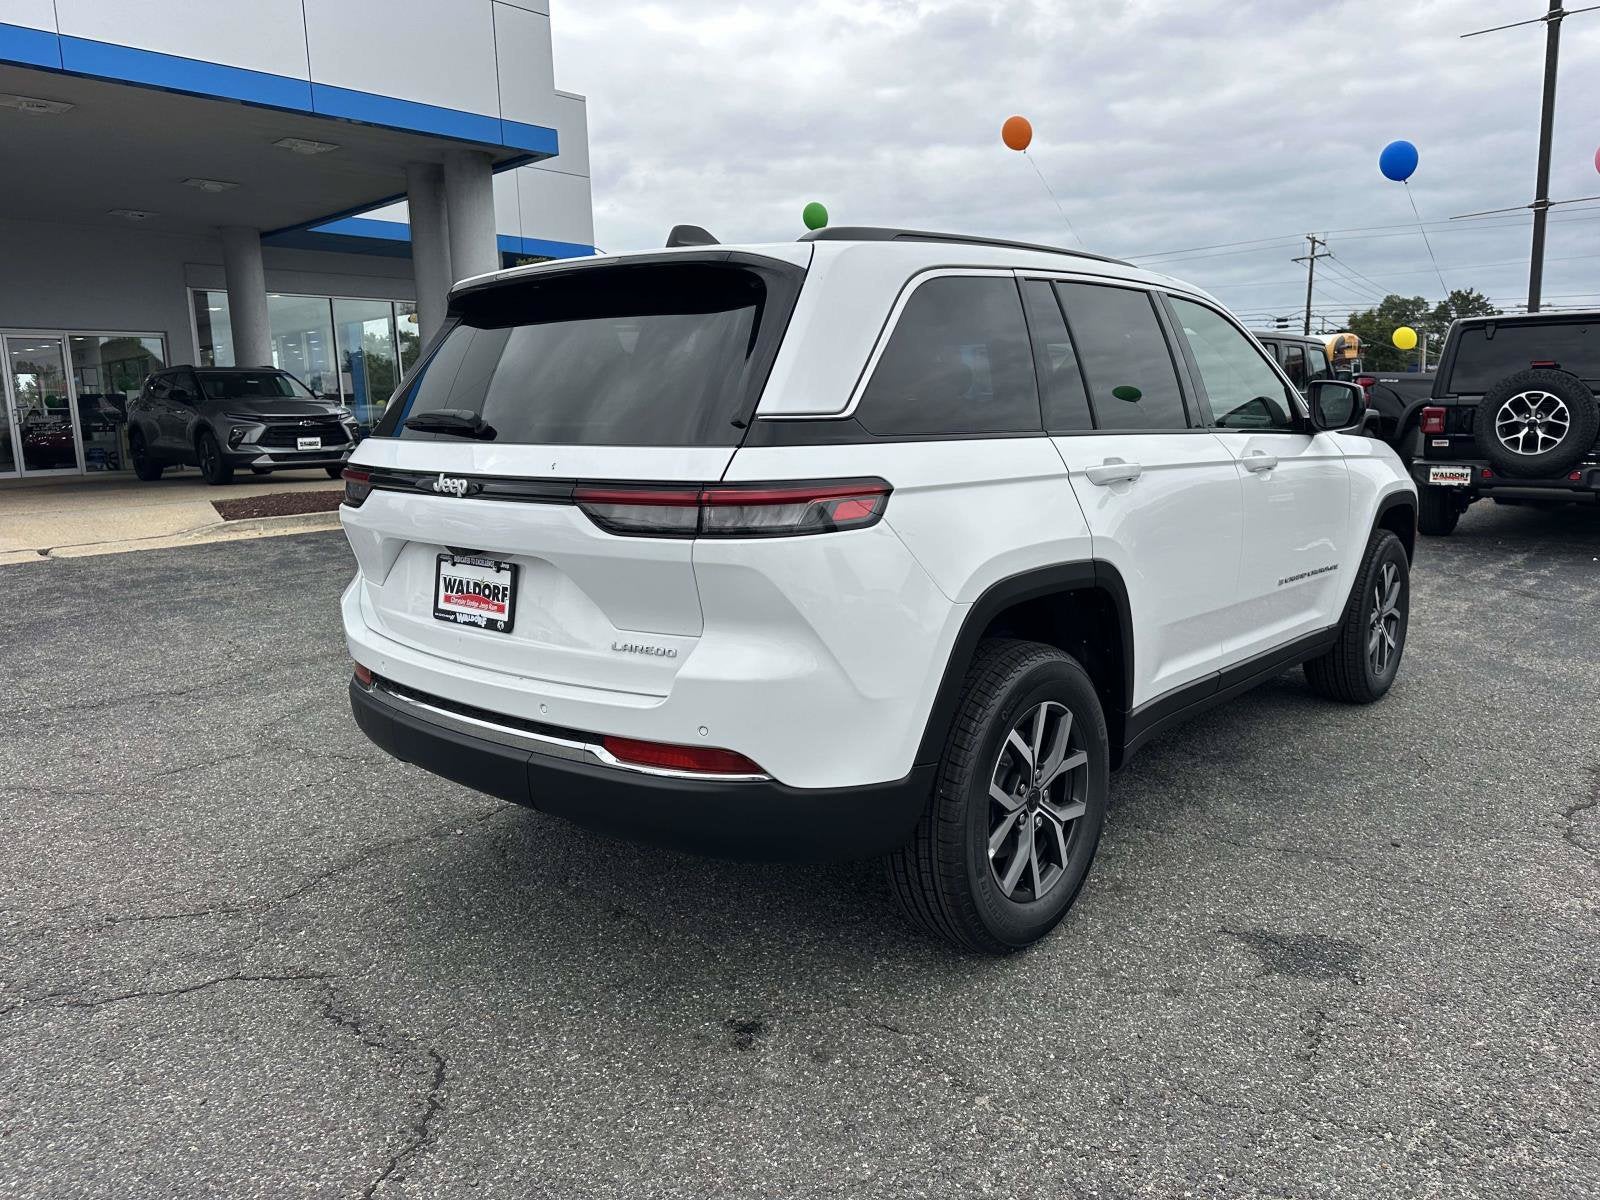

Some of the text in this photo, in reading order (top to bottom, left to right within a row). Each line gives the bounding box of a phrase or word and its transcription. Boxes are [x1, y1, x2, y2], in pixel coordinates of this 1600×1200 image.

[433, 473, 468, 498] Jeep
[442, 575, 509, 603] WALDORF
[456, 612, 487, 627] WALDORF
[611, 642, 678, 658] LAREDO
